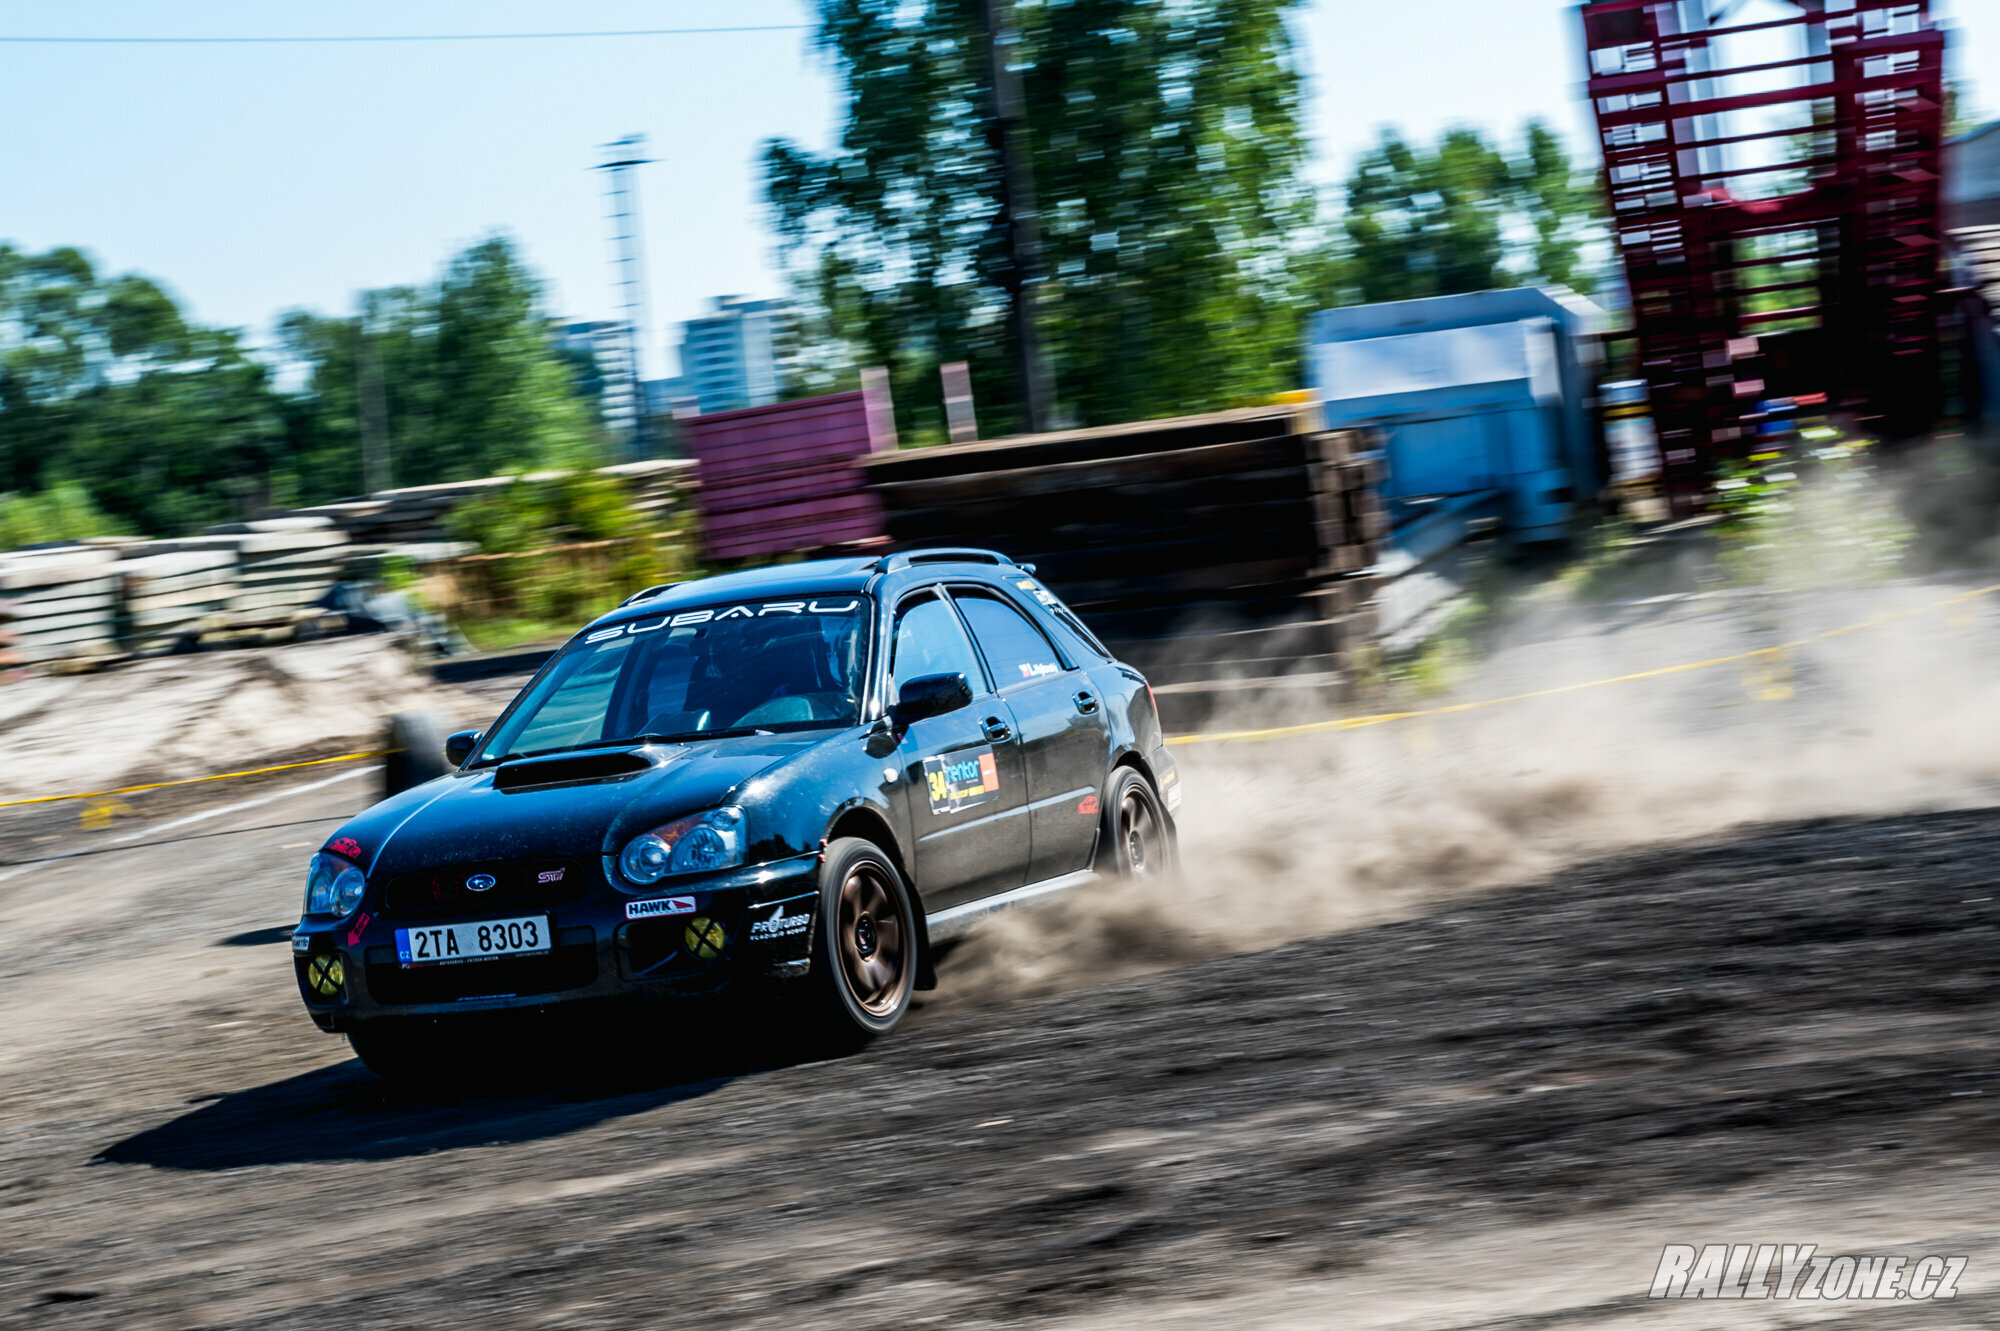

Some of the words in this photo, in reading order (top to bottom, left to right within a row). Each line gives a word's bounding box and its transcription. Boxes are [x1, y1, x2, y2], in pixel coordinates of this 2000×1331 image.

[585, 600, 859, 645] SUBARU
[928, 770, 948, 802] 34
[628, 900, 672, 915] HAWK
[399, 950, 411, 960] CZ
[414, 928, 460, 959] 2TA
[477, 920, 539, 952] 8303
